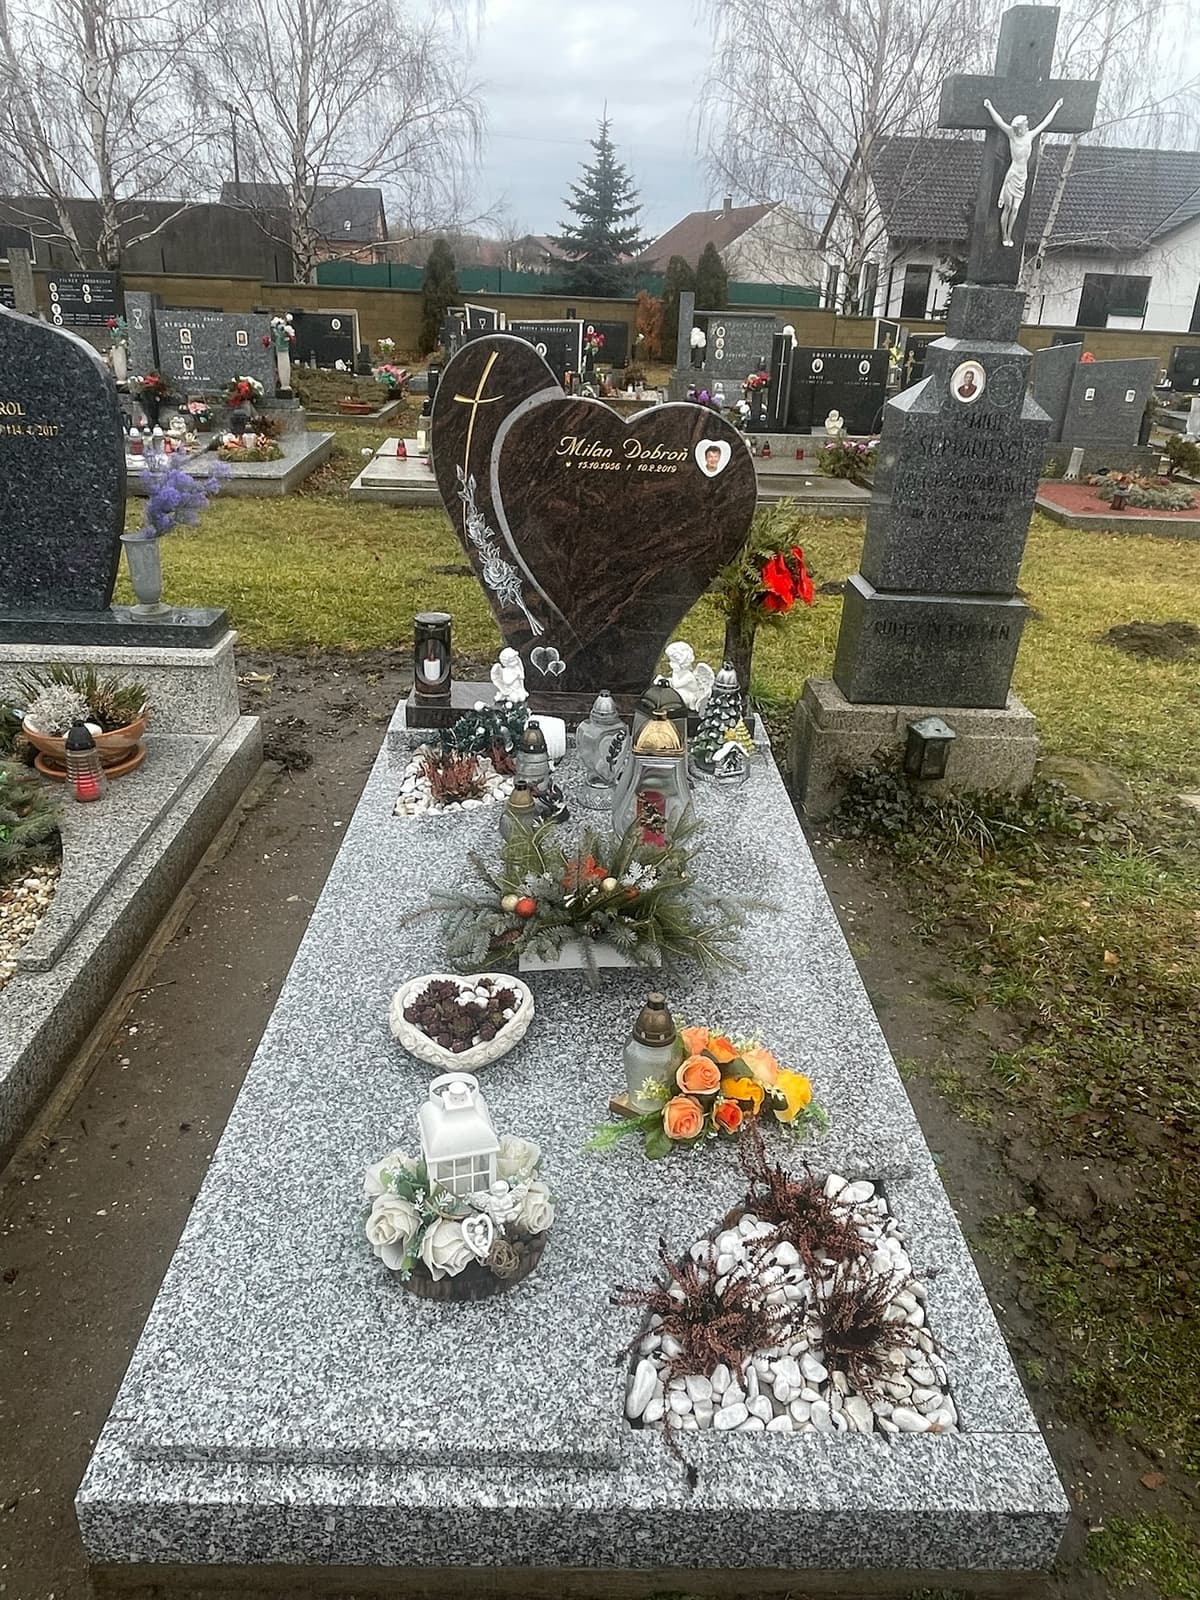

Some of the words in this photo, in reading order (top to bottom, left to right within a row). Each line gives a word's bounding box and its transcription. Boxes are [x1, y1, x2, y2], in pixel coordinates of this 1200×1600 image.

[555, 435, 613, 458] Milan
[622, 438, 689, 462] Dobroň
[637, 463, 678, 473] 10.2.2019
